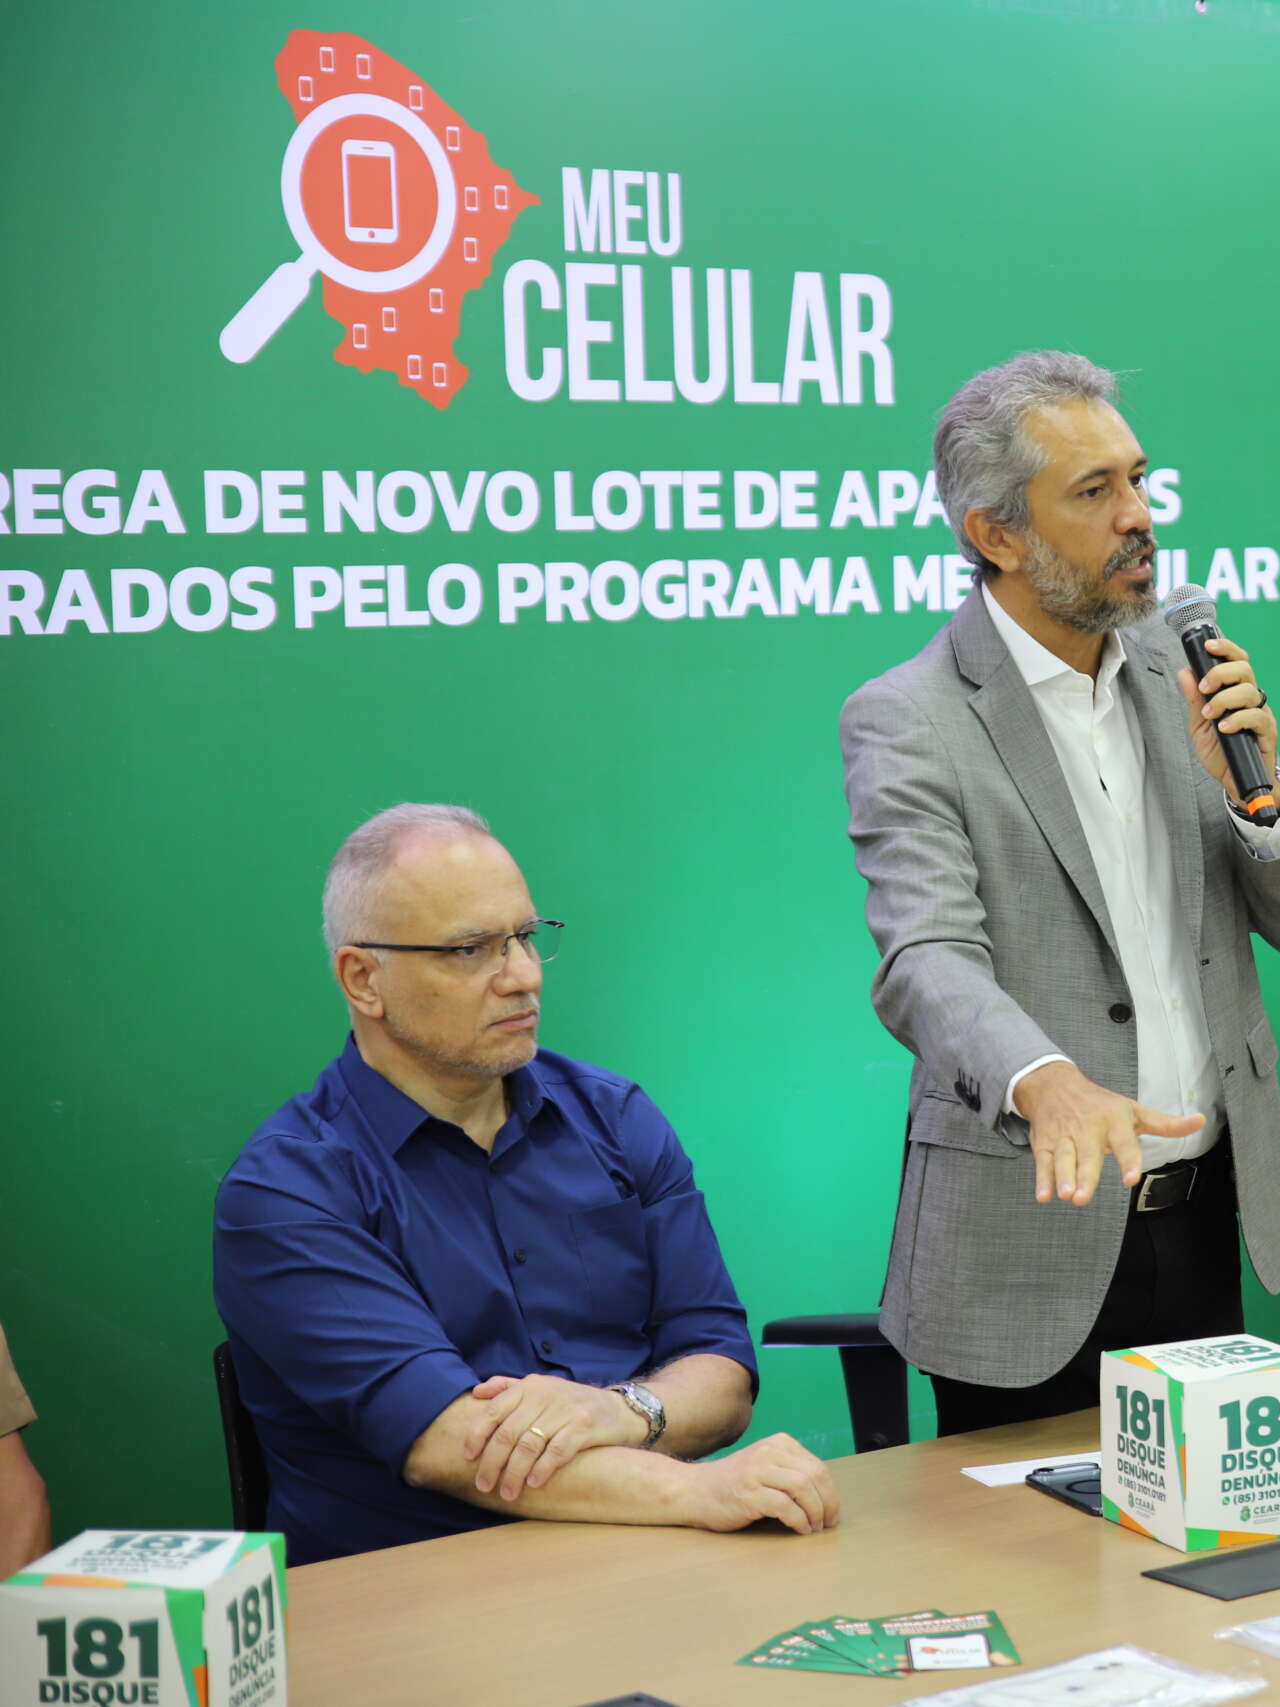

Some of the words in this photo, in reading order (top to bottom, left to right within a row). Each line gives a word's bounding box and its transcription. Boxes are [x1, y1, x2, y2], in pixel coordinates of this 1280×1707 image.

[562, 167, 682, 256] MEU
[502, 260, 896, 404] CELULAR
[0, 469, 187, 535] EGA
[203, 470, 308, 533] DE
[321, 470, 540, 533] NOVO
[553, 470, 723, 531] LOTE
[733, 470, 819, 529] DE
[293, 563, 482, 630] PELO
[498, 556, 881, 625] PROGRAMA
[893, 554, 976, 612] ME
[1116, 1385, 1165, 1448] 181
[1117, 1432, 1166, 1470] DISQUE
[1117, 1458, 1166, 1489] DENÚNCIA
[1233, 1492, 1256, 1505] (85)
[104, 1533, 228, 1553] 181
[226, 1572, 275, 1658] 181
[37, 1616, 160, 1679] 181
[229, 1634, 275, 1688] DISQUE
[39, 1679, 160, 1707] DISQUE
